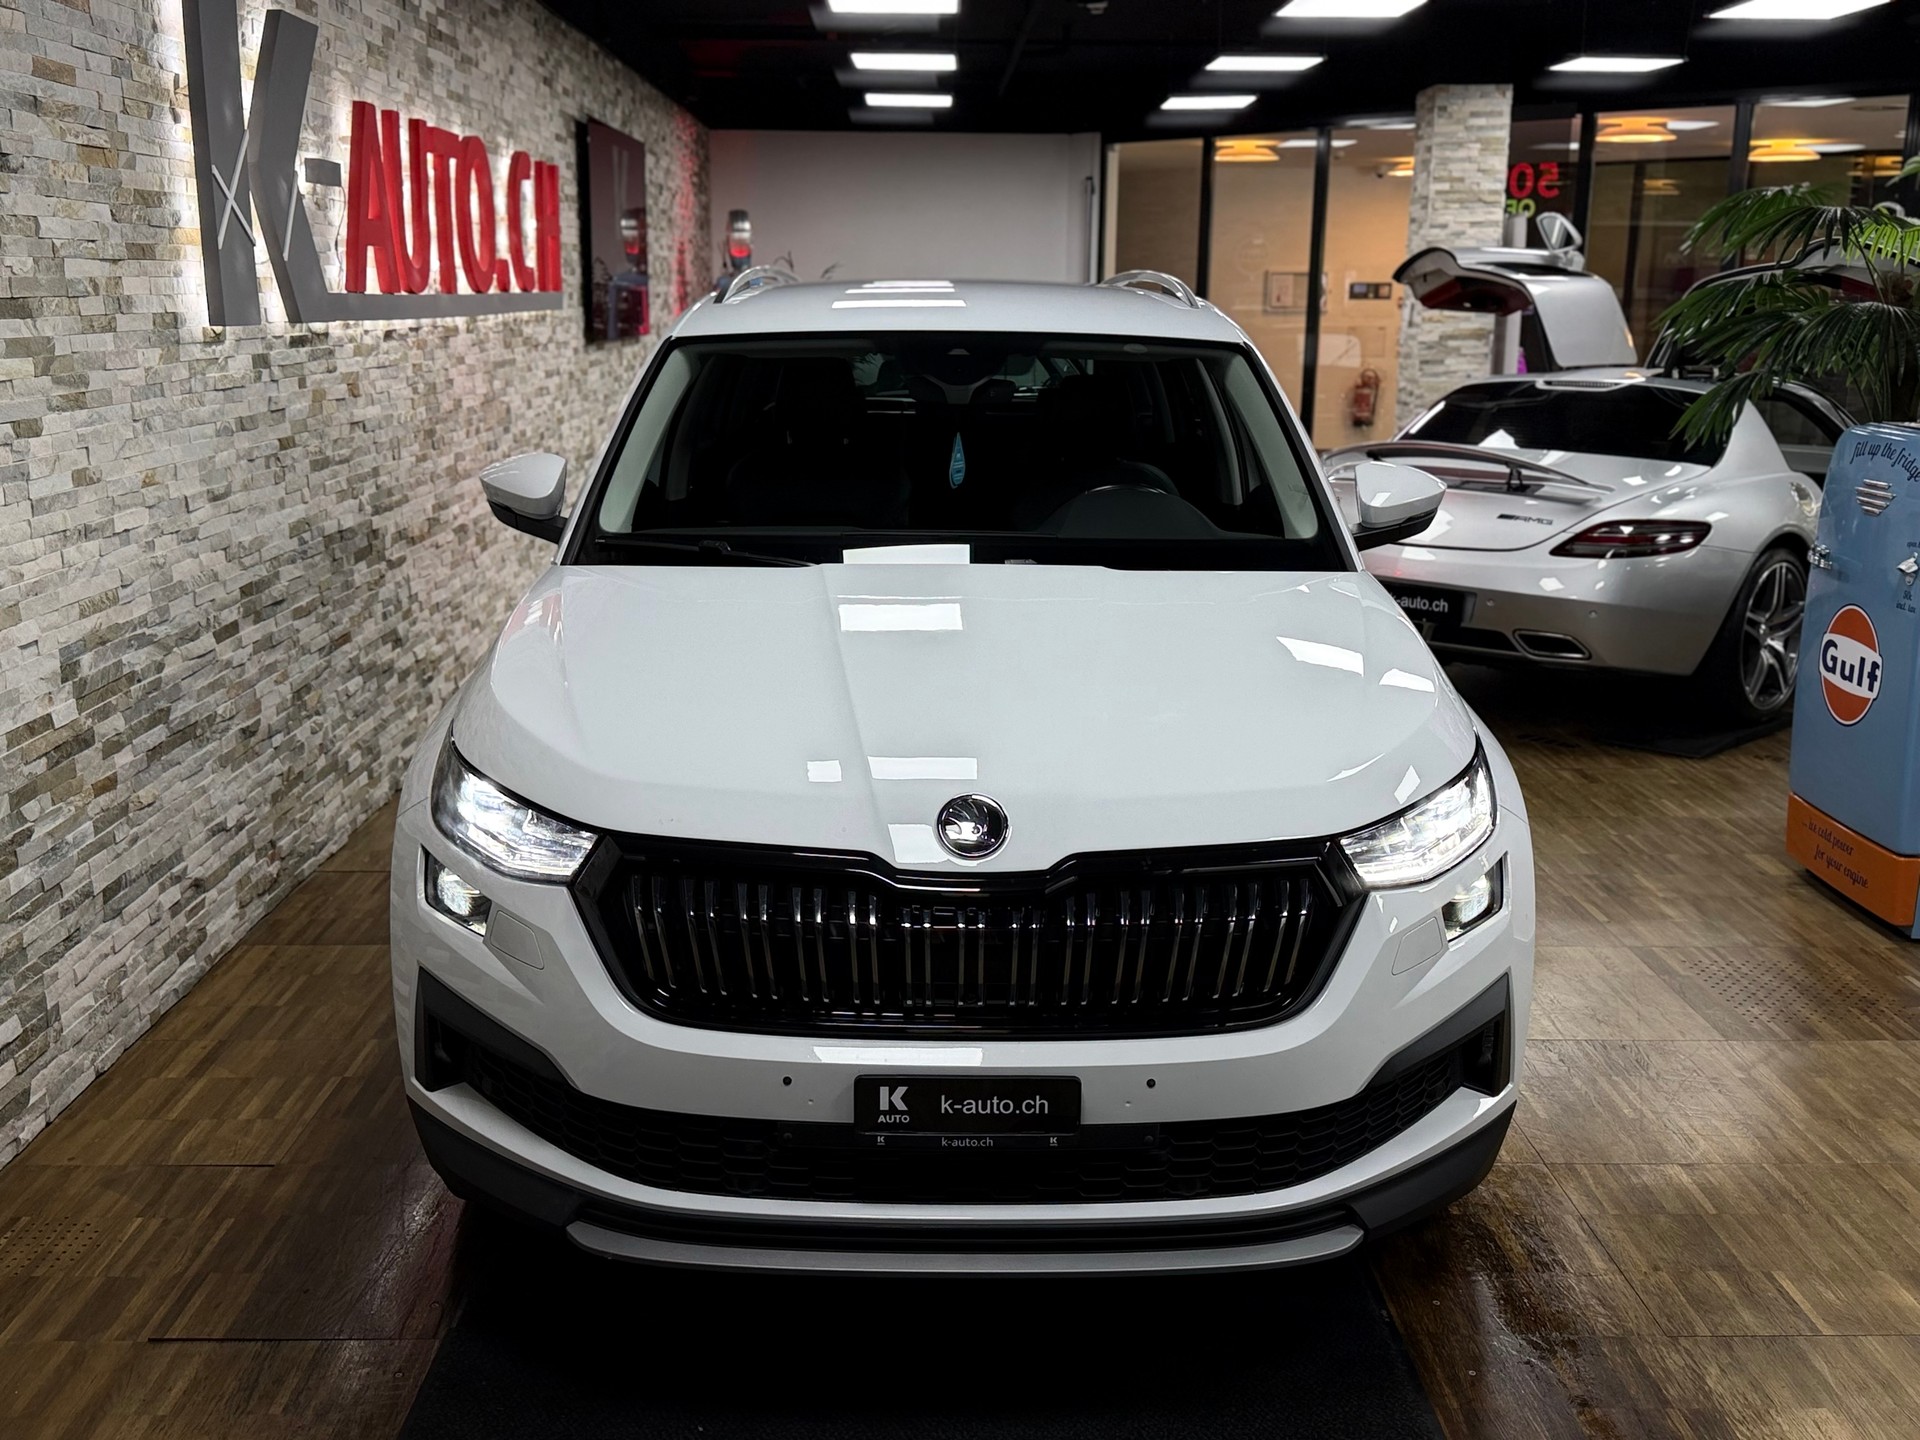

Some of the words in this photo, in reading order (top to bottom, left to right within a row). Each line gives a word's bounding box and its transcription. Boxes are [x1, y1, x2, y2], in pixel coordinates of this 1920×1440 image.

[184, 0, 563, 326] K-AUTO.CH
[1849, 440, 1869, 465] fill
[1867, 443, 1882, 461] up
[1880, 442, 1897, 461] the
[1821, 638, 1881, 693] Gulf
[879, 1086, 909, 1111] K
[940, 1095, 1049, 1114] k-auto.ch
[877, 1114, 910, 1123] AUTO
[941, 1137, 994, 1147] k-auto.ch
